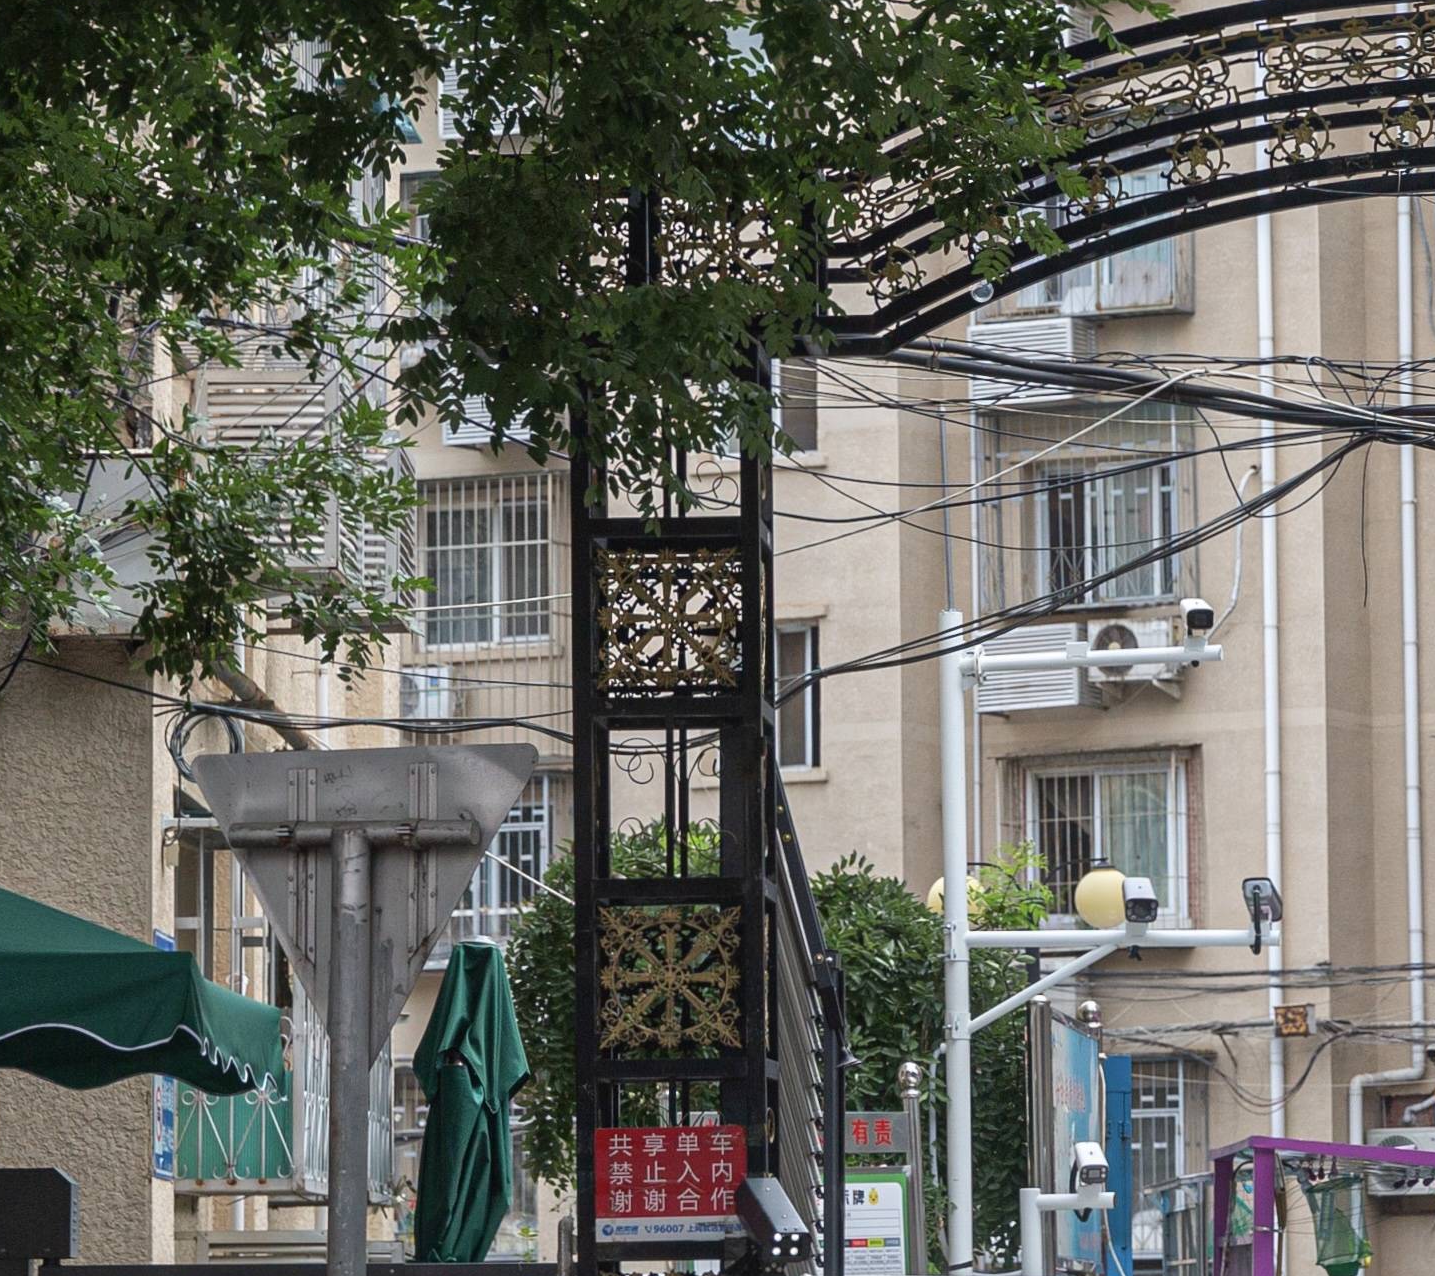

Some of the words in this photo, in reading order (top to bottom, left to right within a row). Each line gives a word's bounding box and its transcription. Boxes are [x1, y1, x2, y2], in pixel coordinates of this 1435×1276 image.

[608, 1132, 734, 1157] 共享单车
[851, 1119, 893, 1146] 有责
[609, 1159, 734, 1185] 禁止入内
[609, 1186, 735, 1213] 谢谢合作
[653, 1224, 684, 1233] 96007
